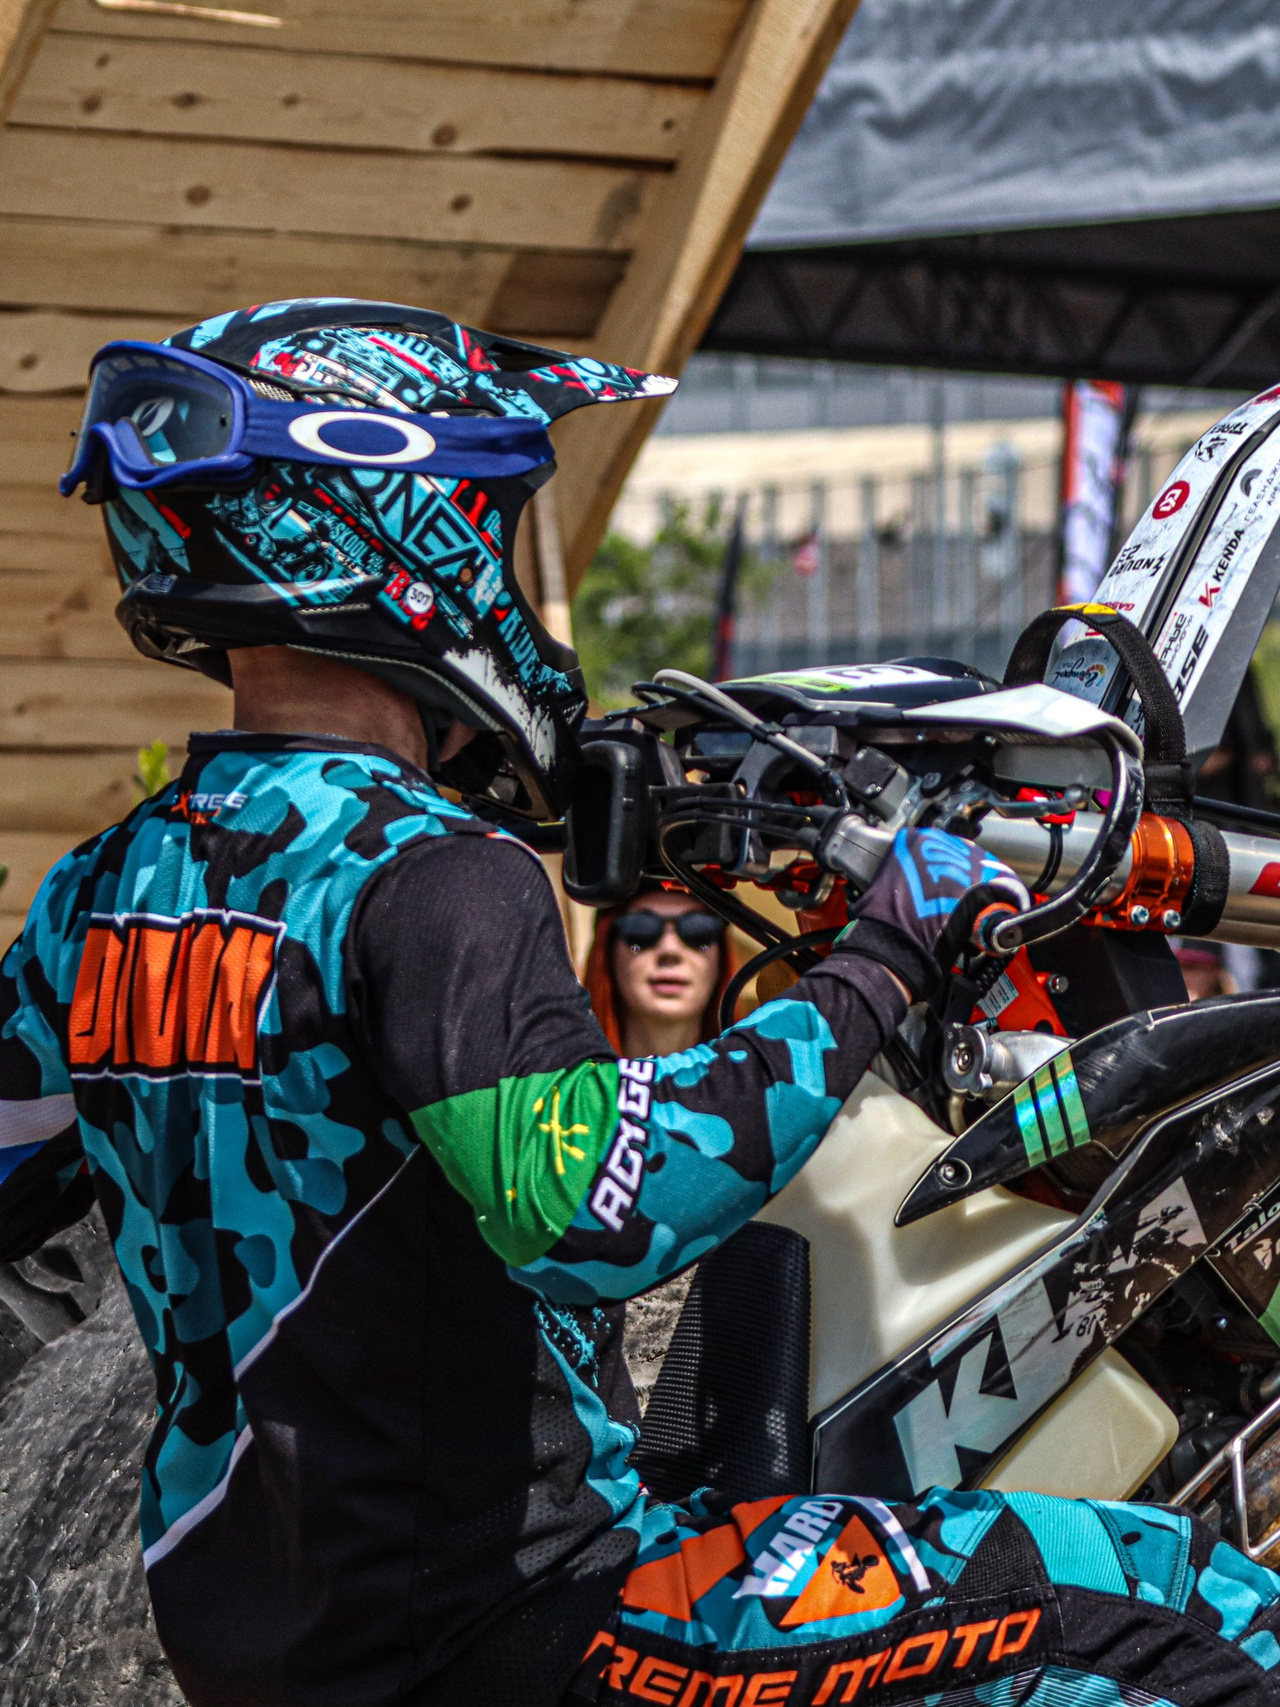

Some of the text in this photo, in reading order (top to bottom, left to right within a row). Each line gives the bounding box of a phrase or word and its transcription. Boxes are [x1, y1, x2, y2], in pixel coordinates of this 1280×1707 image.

[1212, 528, 1246, 582] KENDA
[409, 587, 432, 607] 307
[731, 1499, 844, 1599] HARD
[811, 1608, 1042, 1706] MOTO
